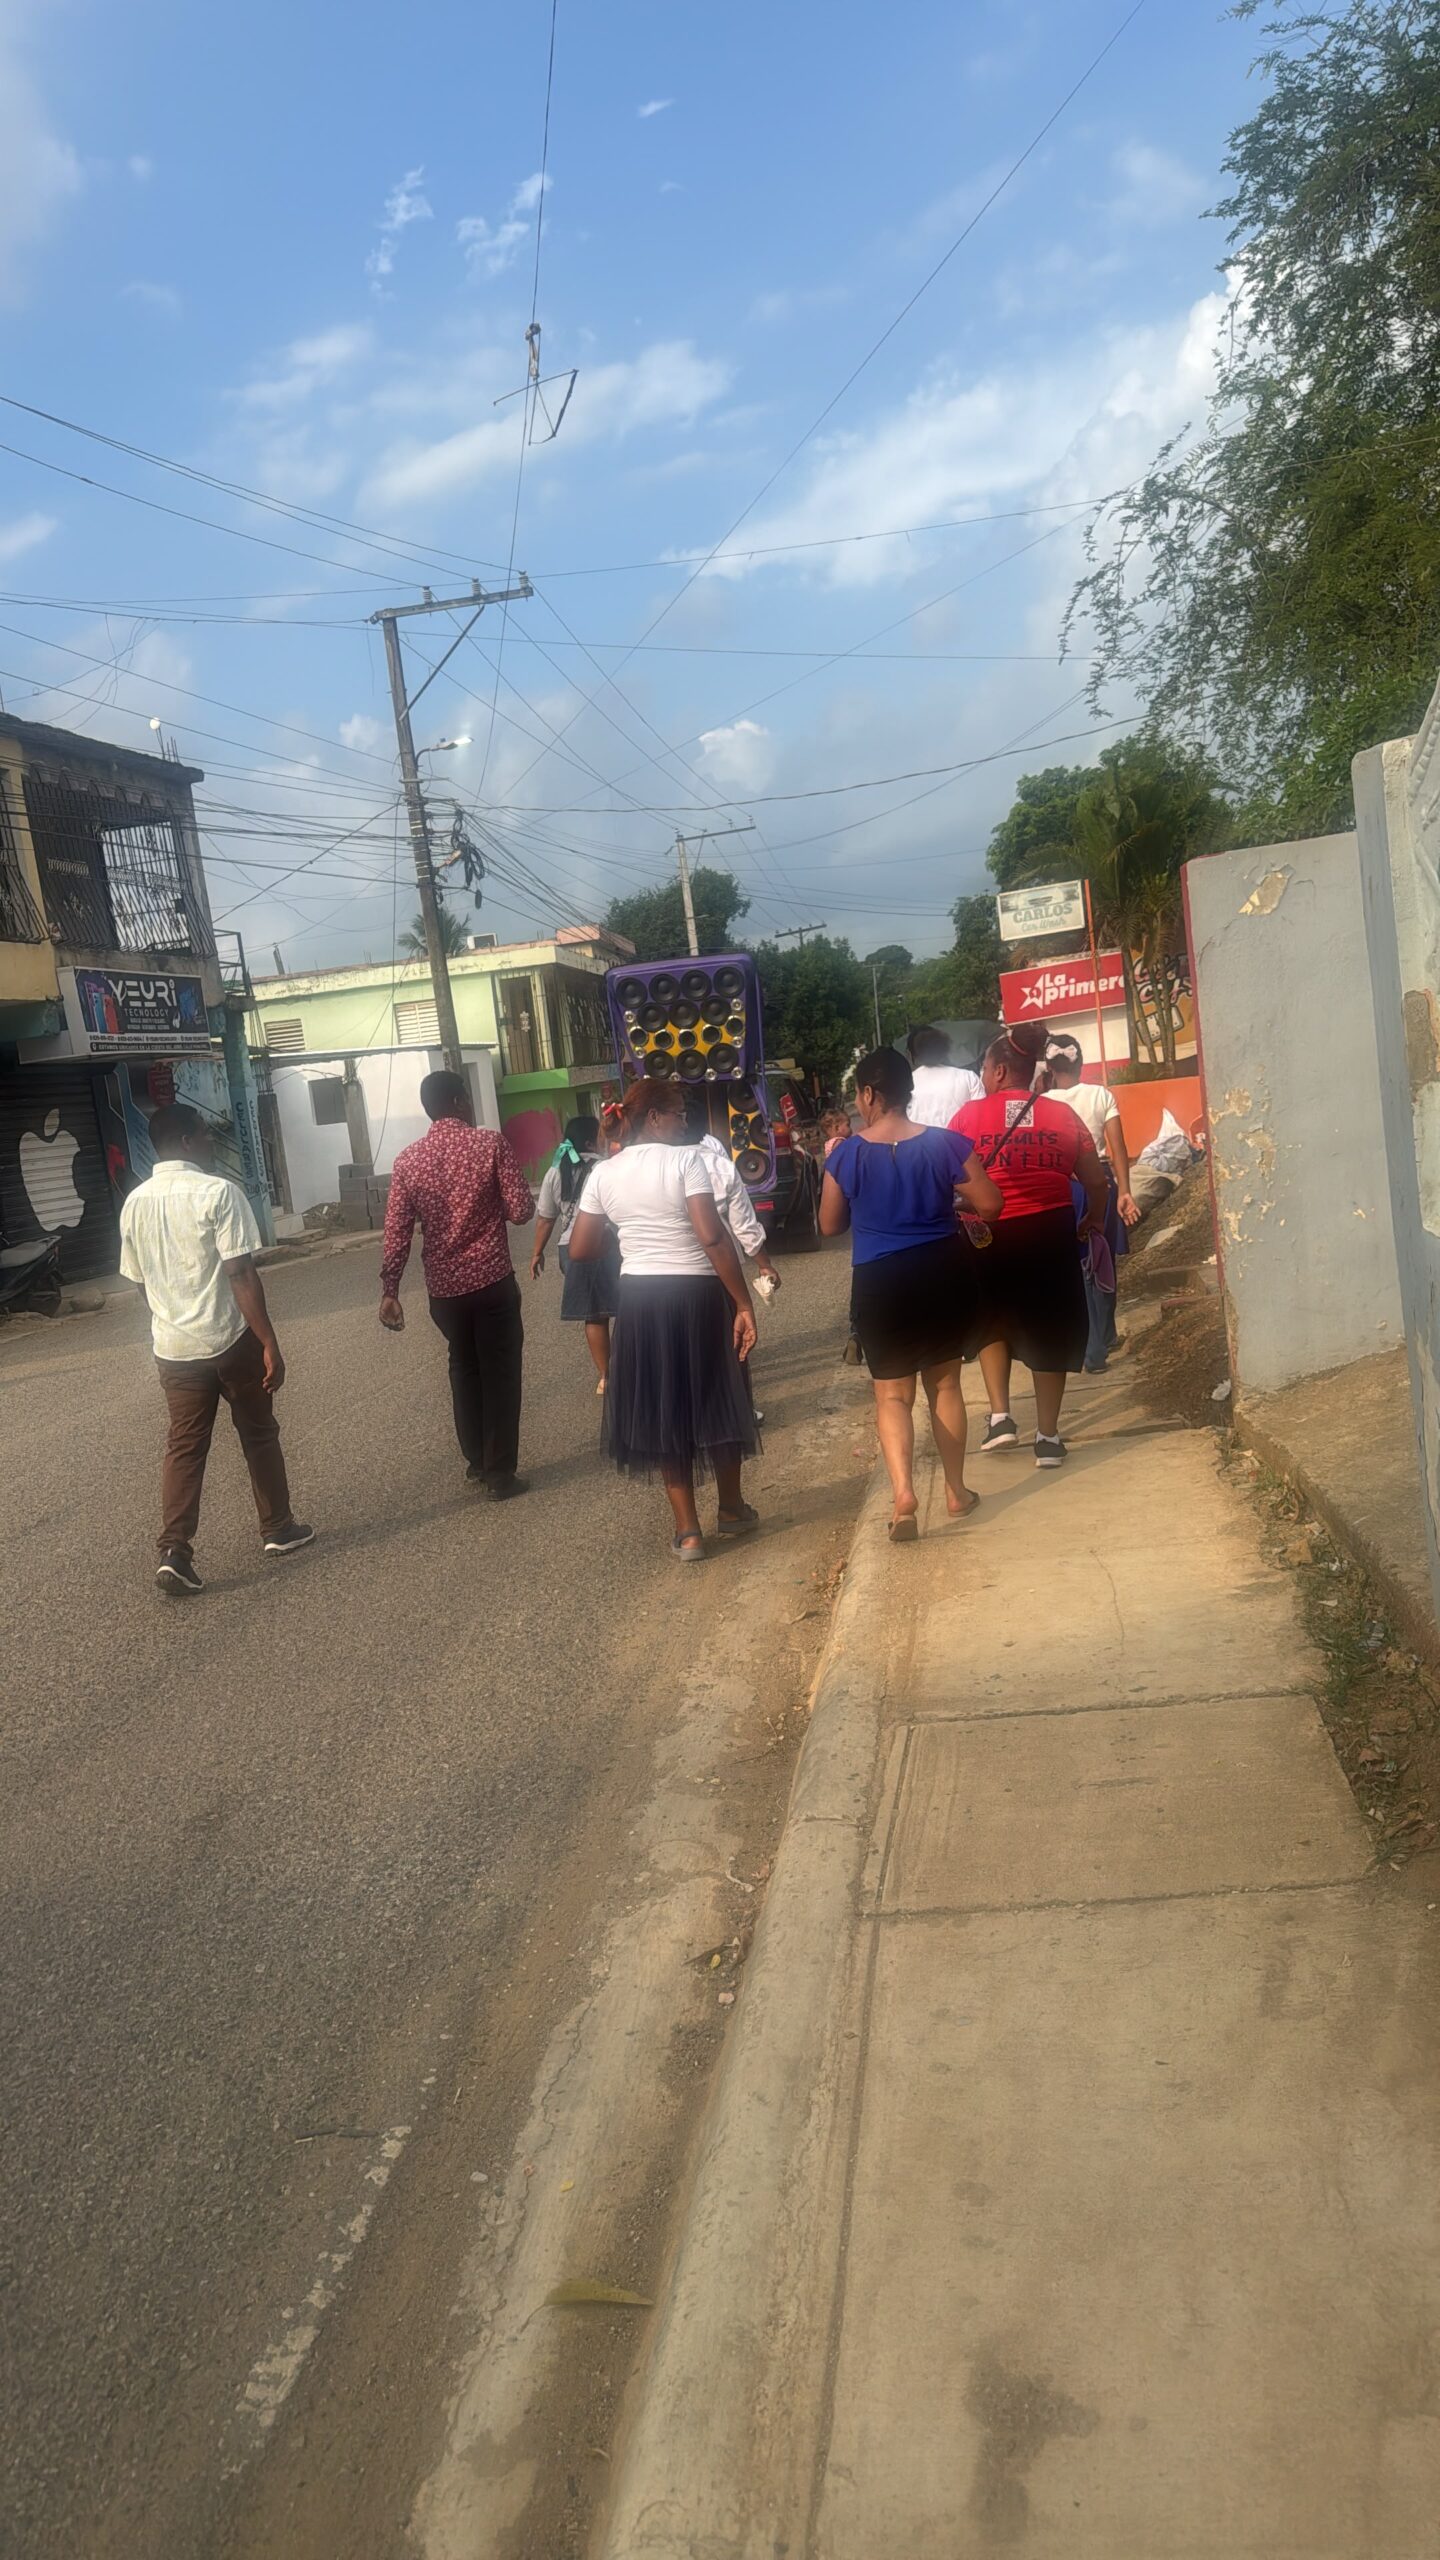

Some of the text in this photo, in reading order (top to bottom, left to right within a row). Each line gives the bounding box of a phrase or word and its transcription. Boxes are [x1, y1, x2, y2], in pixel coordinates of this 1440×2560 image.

[1013, 903, 1073, 923] CARLOS
[1044, 973, 1066, 988] La
[124, 1008, 169, 1017] TECNOLOGY
